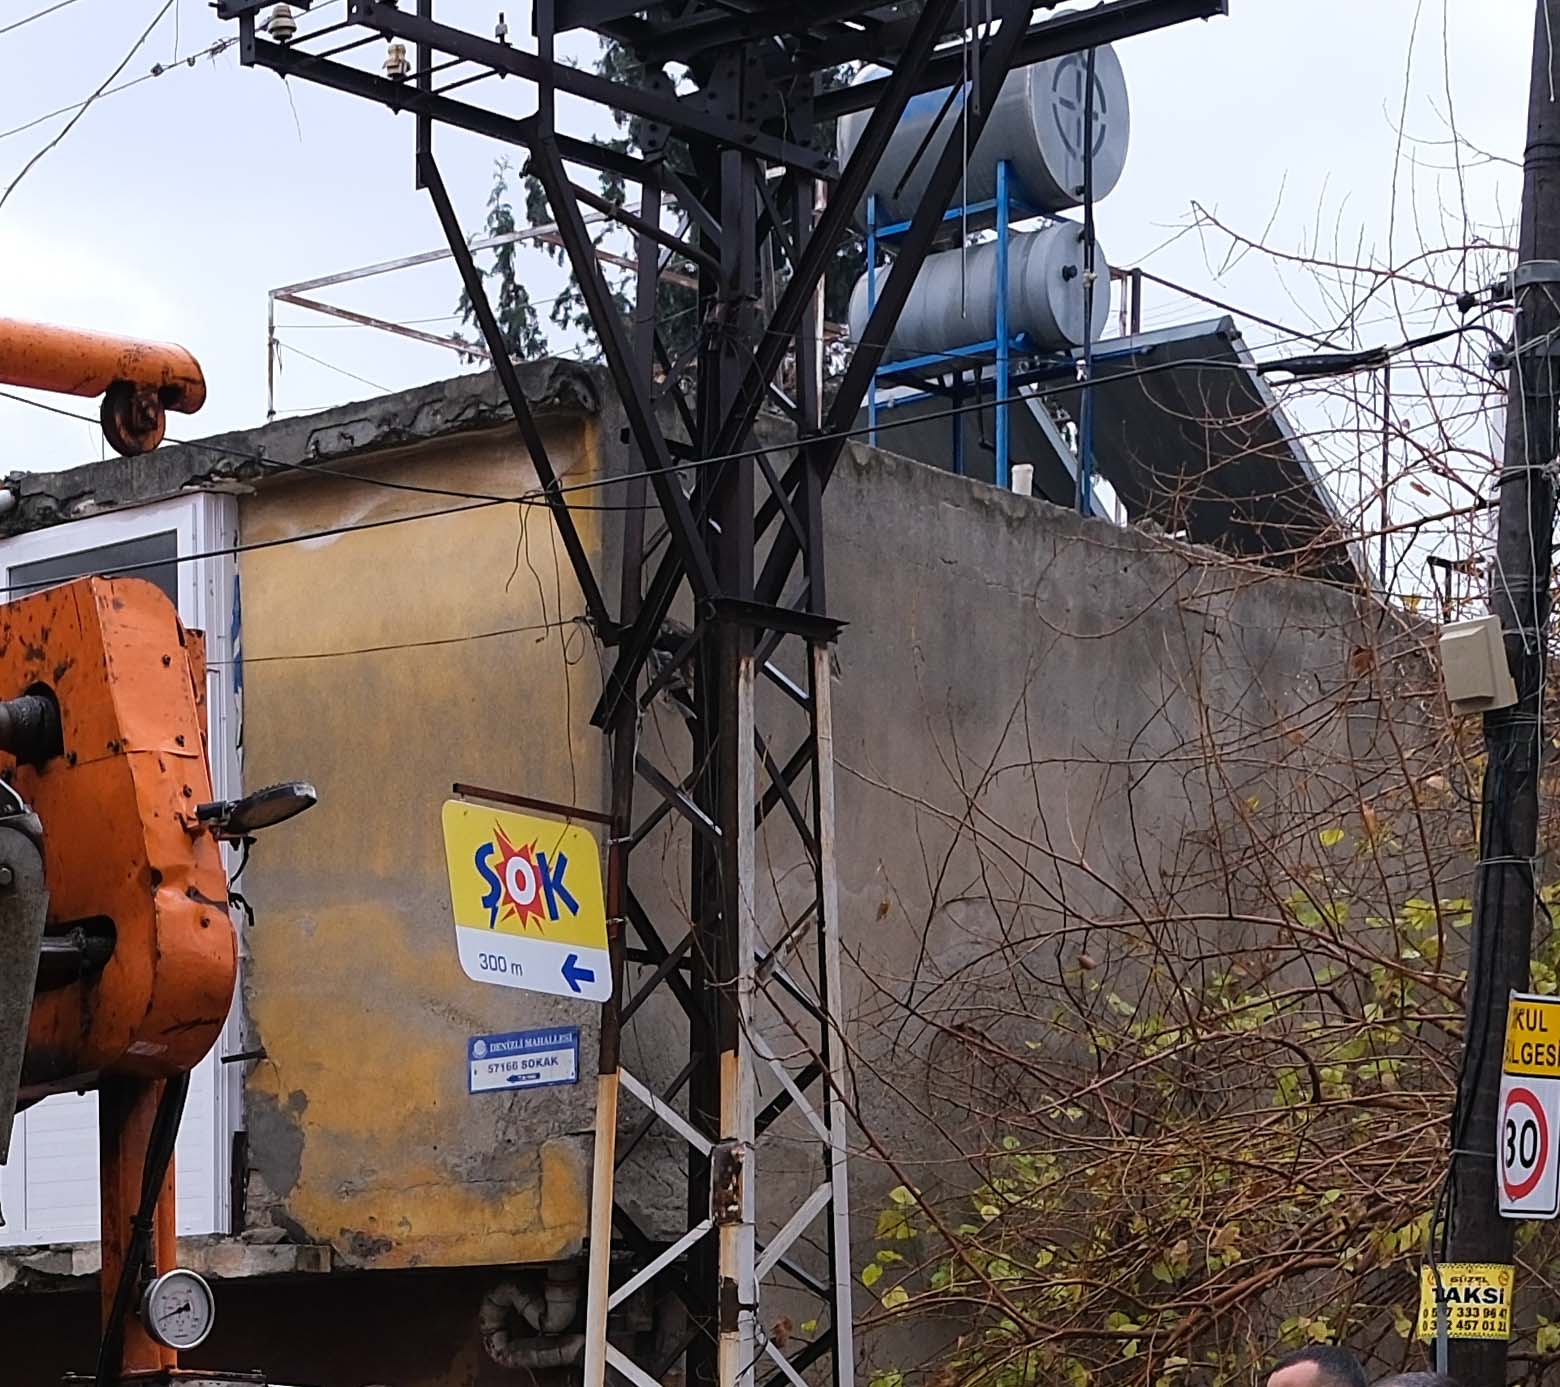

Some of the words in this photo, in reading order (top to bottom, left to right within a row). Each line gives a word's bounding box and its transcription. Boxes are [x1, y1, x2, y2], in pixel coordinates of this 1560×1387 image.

[475, 841, 580, 929] ŞOK
[479, 953, 508, 974] 300
[510, 960, 523, 977] m
[490, 1038, 523, 1053] DENİZLİ
[525, 1032, 572, 1048] MAHALLESİ
[521, 1056, 559, 1070] SOKAK
[1506, 1119, 1538, 1169] 30
[1432, 1307, 1453, 1318] 57
[1430, 1320, 1453, 1331] 32
